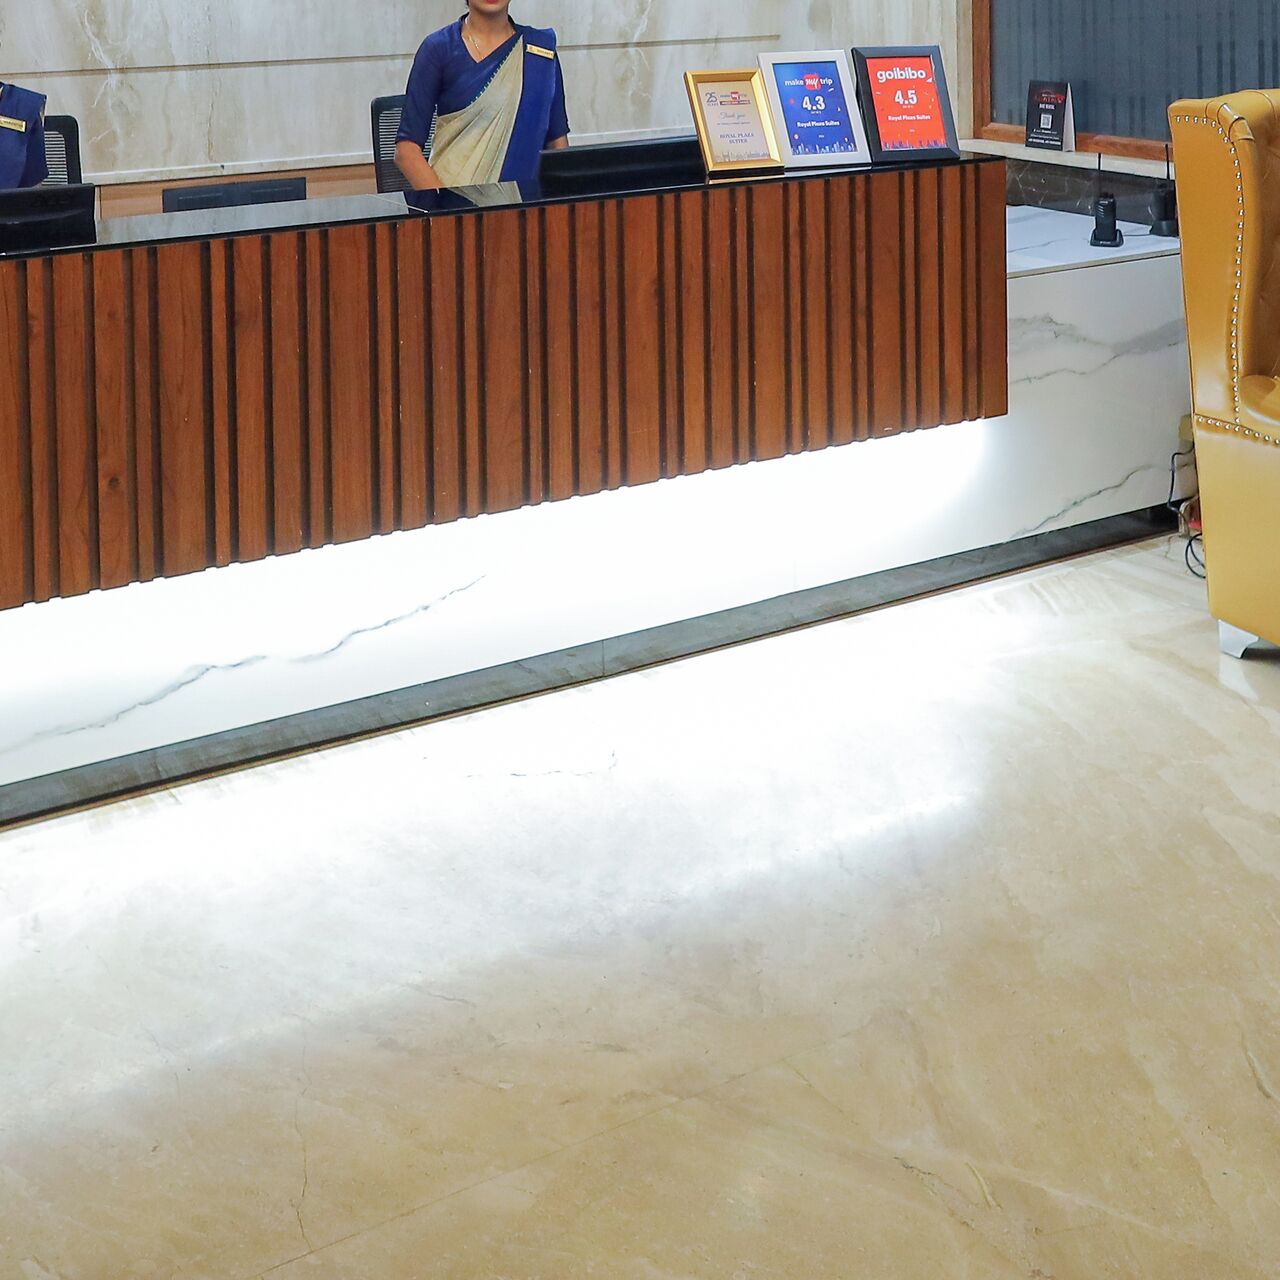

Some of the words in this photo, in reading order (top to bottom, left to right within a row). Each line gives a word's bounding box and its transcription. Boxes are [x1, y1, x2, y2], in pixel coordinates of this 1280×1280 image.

[876, 66, 926, 83] goibibo
[784, 78, 804, 86] make
[805, 78, 819, 89] my
[820, 77, 833, 86] trip
[705, 92, 718, 103] 25
[802, 95, 826, 111] 4.3
[894, 89, 918, 105] 4.5
